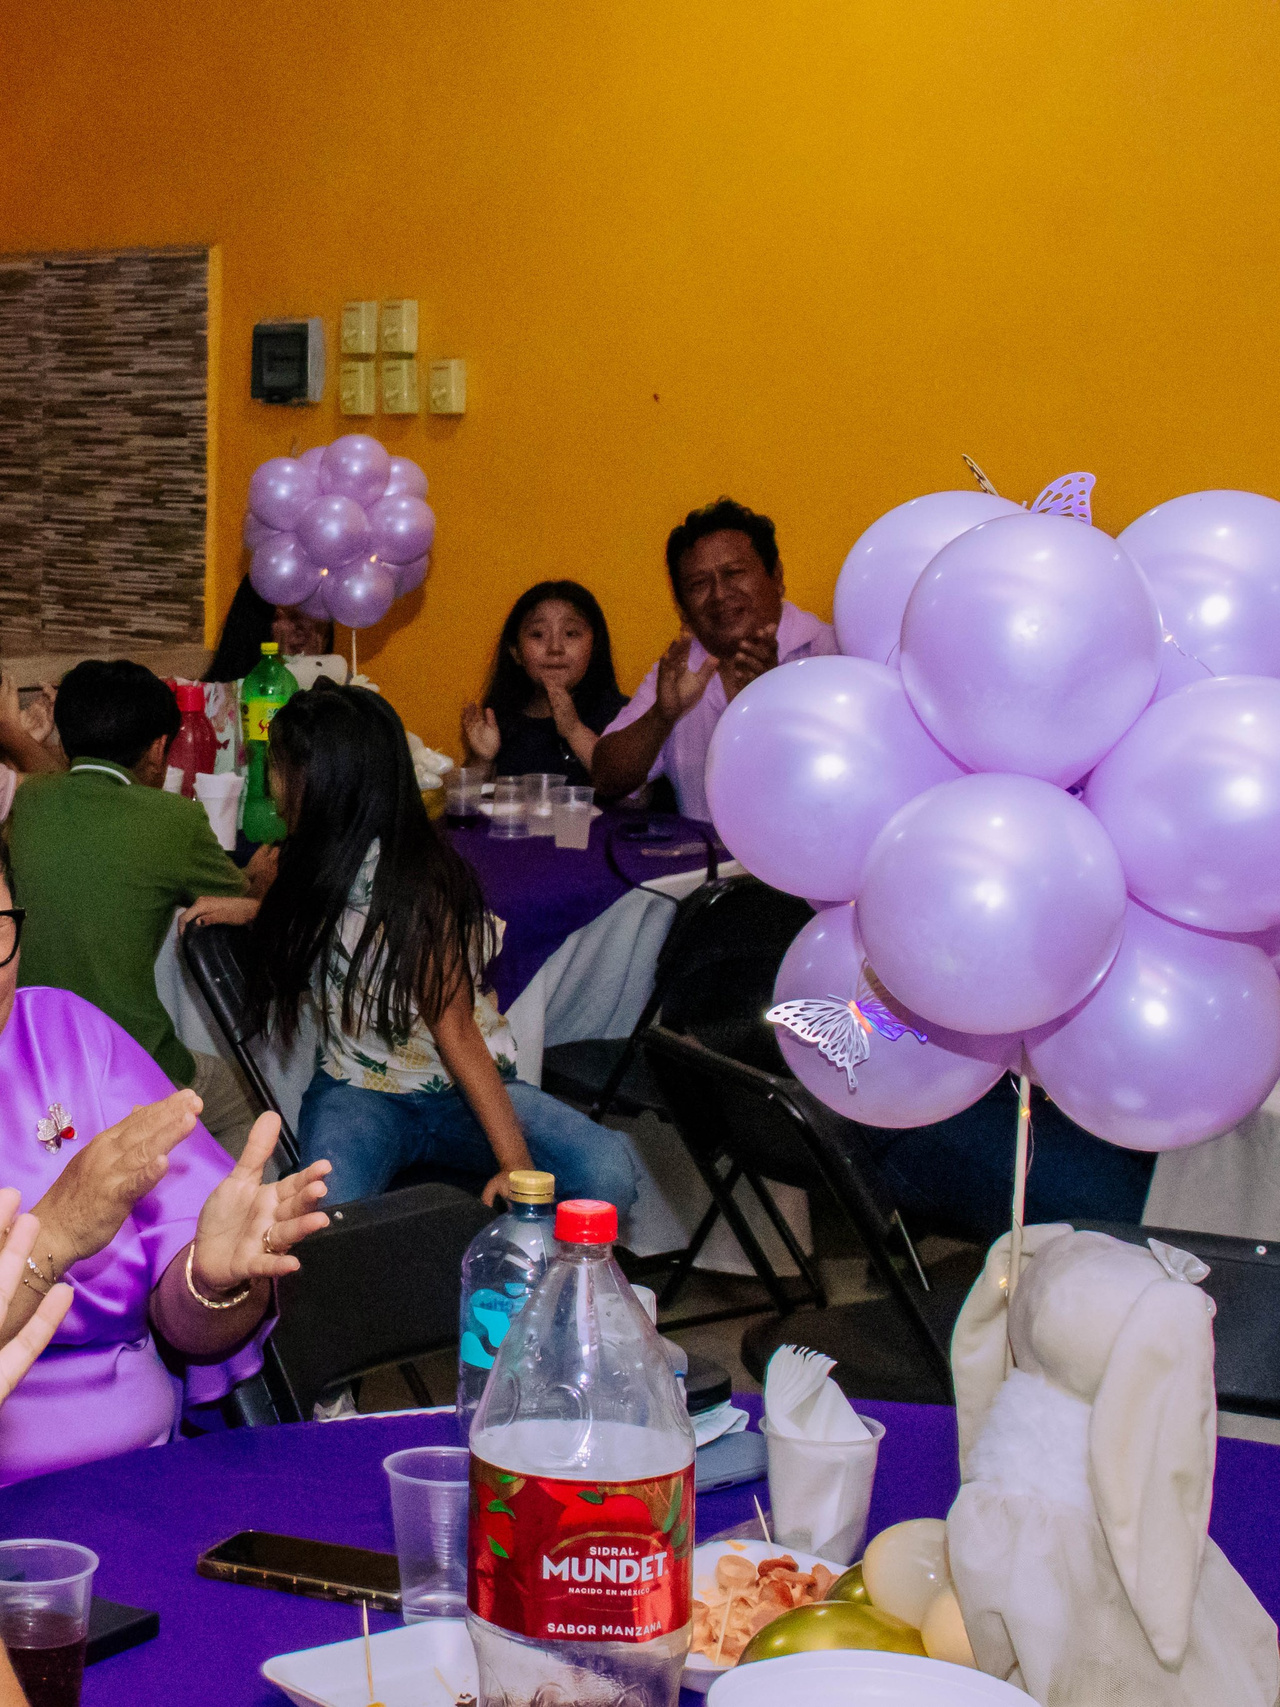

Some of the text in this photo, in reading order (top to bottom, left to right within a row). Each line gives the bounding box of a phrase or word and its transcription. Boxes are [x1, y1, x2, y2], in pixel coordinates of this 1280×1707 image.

[589, 1546, 635, 1556] SIDRAL
[542, 1551, 668, 1584] MUNDET
[568, 1587, 603, 1595] NACIDO
[620, 1587, 650, 1597] MÉXICO
[547, 1620, 662, 1637] SABOR MANZANA
